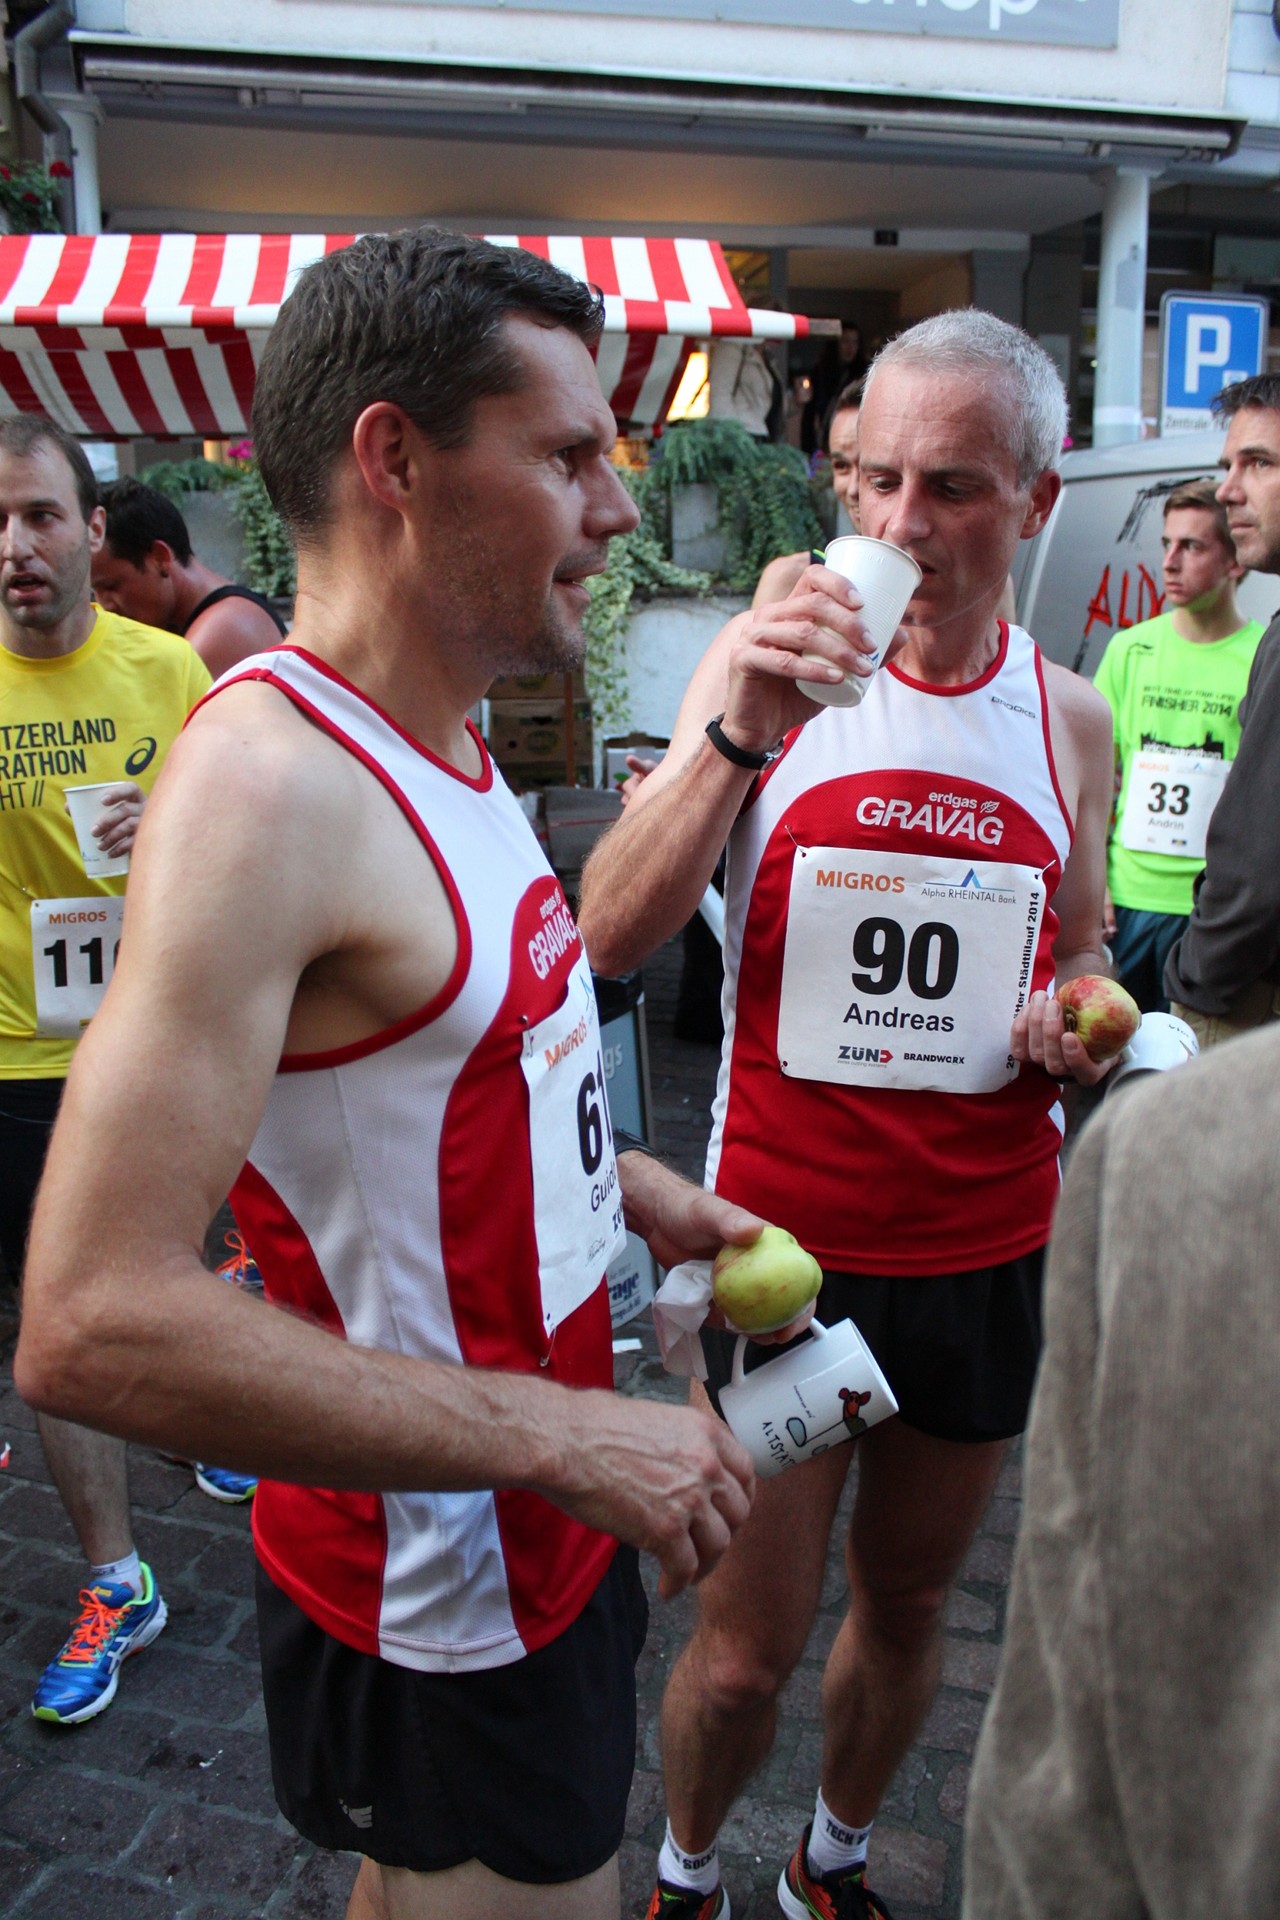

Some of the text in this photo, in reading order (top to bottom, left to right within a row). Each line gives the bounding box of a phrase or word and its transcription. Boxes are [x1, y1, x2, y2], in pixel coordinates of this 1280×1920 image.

[1183, 312, 1232, 394] P
[1141, 694, 1233, 718] FINISHER 2014
[0, 717, 117, 751] TZERLAND
[928, 791, 978, 810] erdgas
[1147, 782, 1191, 816] 33
[856, 796, 1005, 846] GRAVAG
[1148, 817, 1185, 832] Andrin
[815, 869, 906, 894] MIGROS
[920, 887, 1017, 904] Alpha RHEINTAL Bank
[48, 910, 107, 925] MIGROS
[528, 904, 577, 980] GRAVAG
[1018, 926, 1036, 989] Städtlilauf
[1027, 891, 1040, 923] 2014
[43, 936, 122, 988] 11
[851, 916, 960, 1000] 90
[843, 1002, 956, 1034] Andreas
[826, 1818, 855, 1846] TECH
